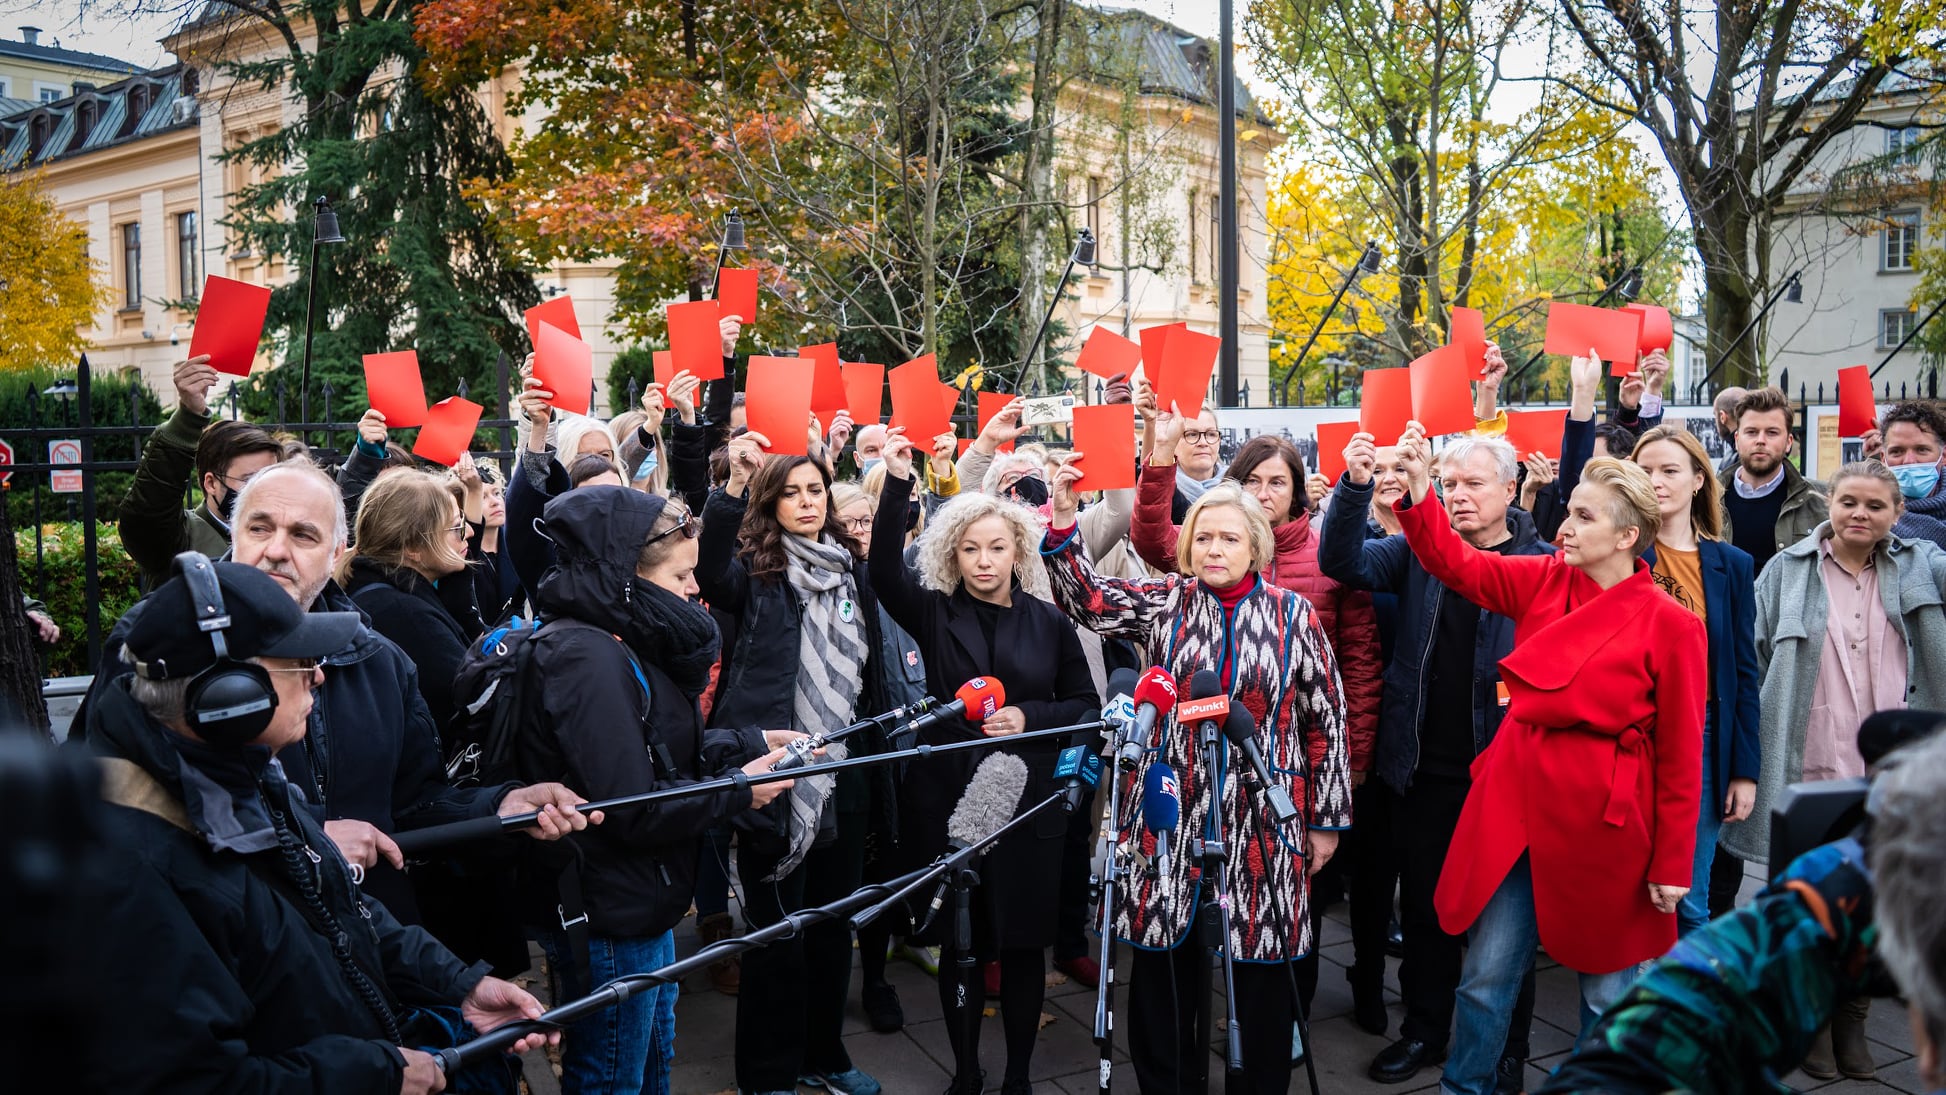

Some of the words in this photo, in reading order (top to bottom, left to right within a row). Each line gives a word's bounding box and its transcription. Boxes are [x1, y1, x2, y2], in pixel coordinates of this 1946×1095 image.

[1182, 701, 1224, 715] wPunkt
[1059, 762, 1076, 771] polsat
[1082, 766, 1098, 780] polsat
[1082, 773, 1095, 784] news
